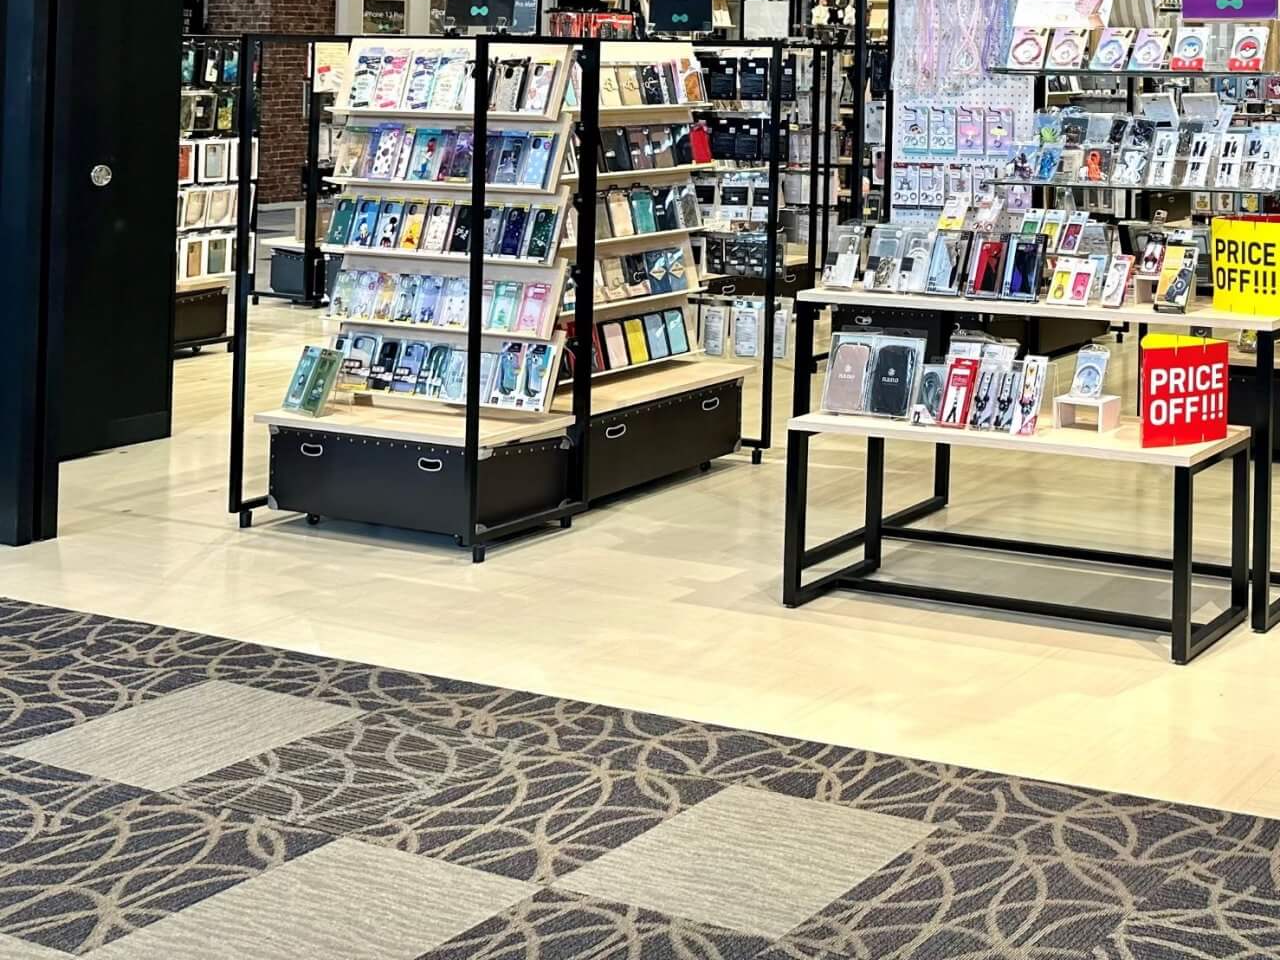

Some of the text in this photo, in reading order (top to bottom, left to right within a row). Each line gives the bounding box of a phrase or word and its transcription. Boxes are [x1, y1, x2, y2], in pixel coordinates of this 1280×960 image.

[1215, 238, 1276, 267] PRICE
[1216, 266, 1277, 295] OFF!!!
[1150, 362, 1225, 396] PRICE
[1149, 391, 1224, 426] OFF!!!
